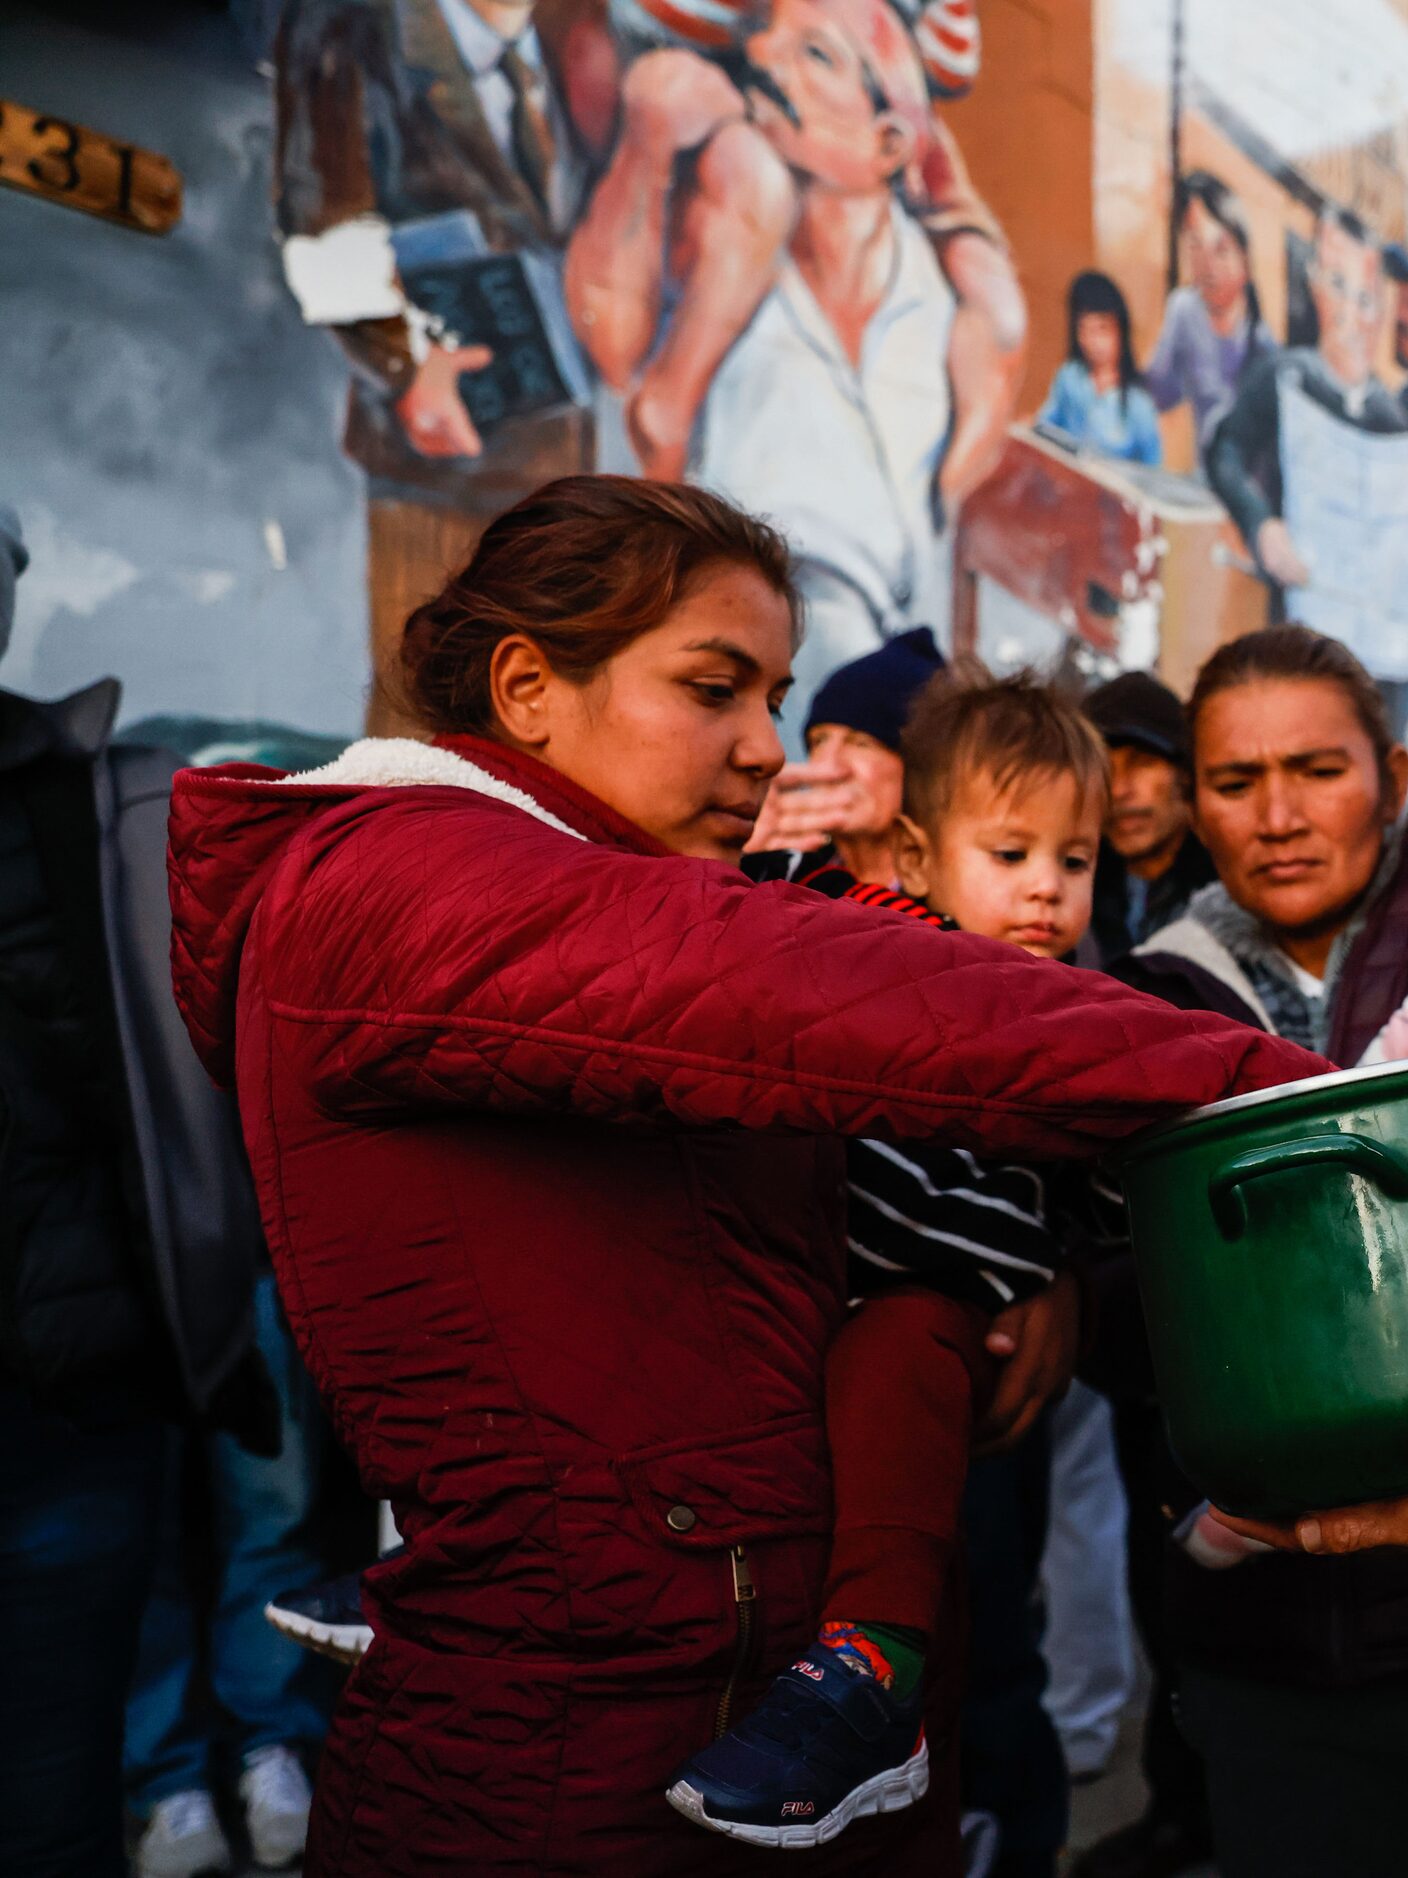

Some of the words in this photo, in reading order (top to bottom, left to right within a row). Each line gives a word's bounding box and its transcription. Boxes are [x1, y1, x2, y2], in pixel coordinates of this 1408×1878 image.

[0, 112, 132, 212] 31
[791, 1660, 824, 1681] FILA
[781, 1801, 815, 1817] FILA
